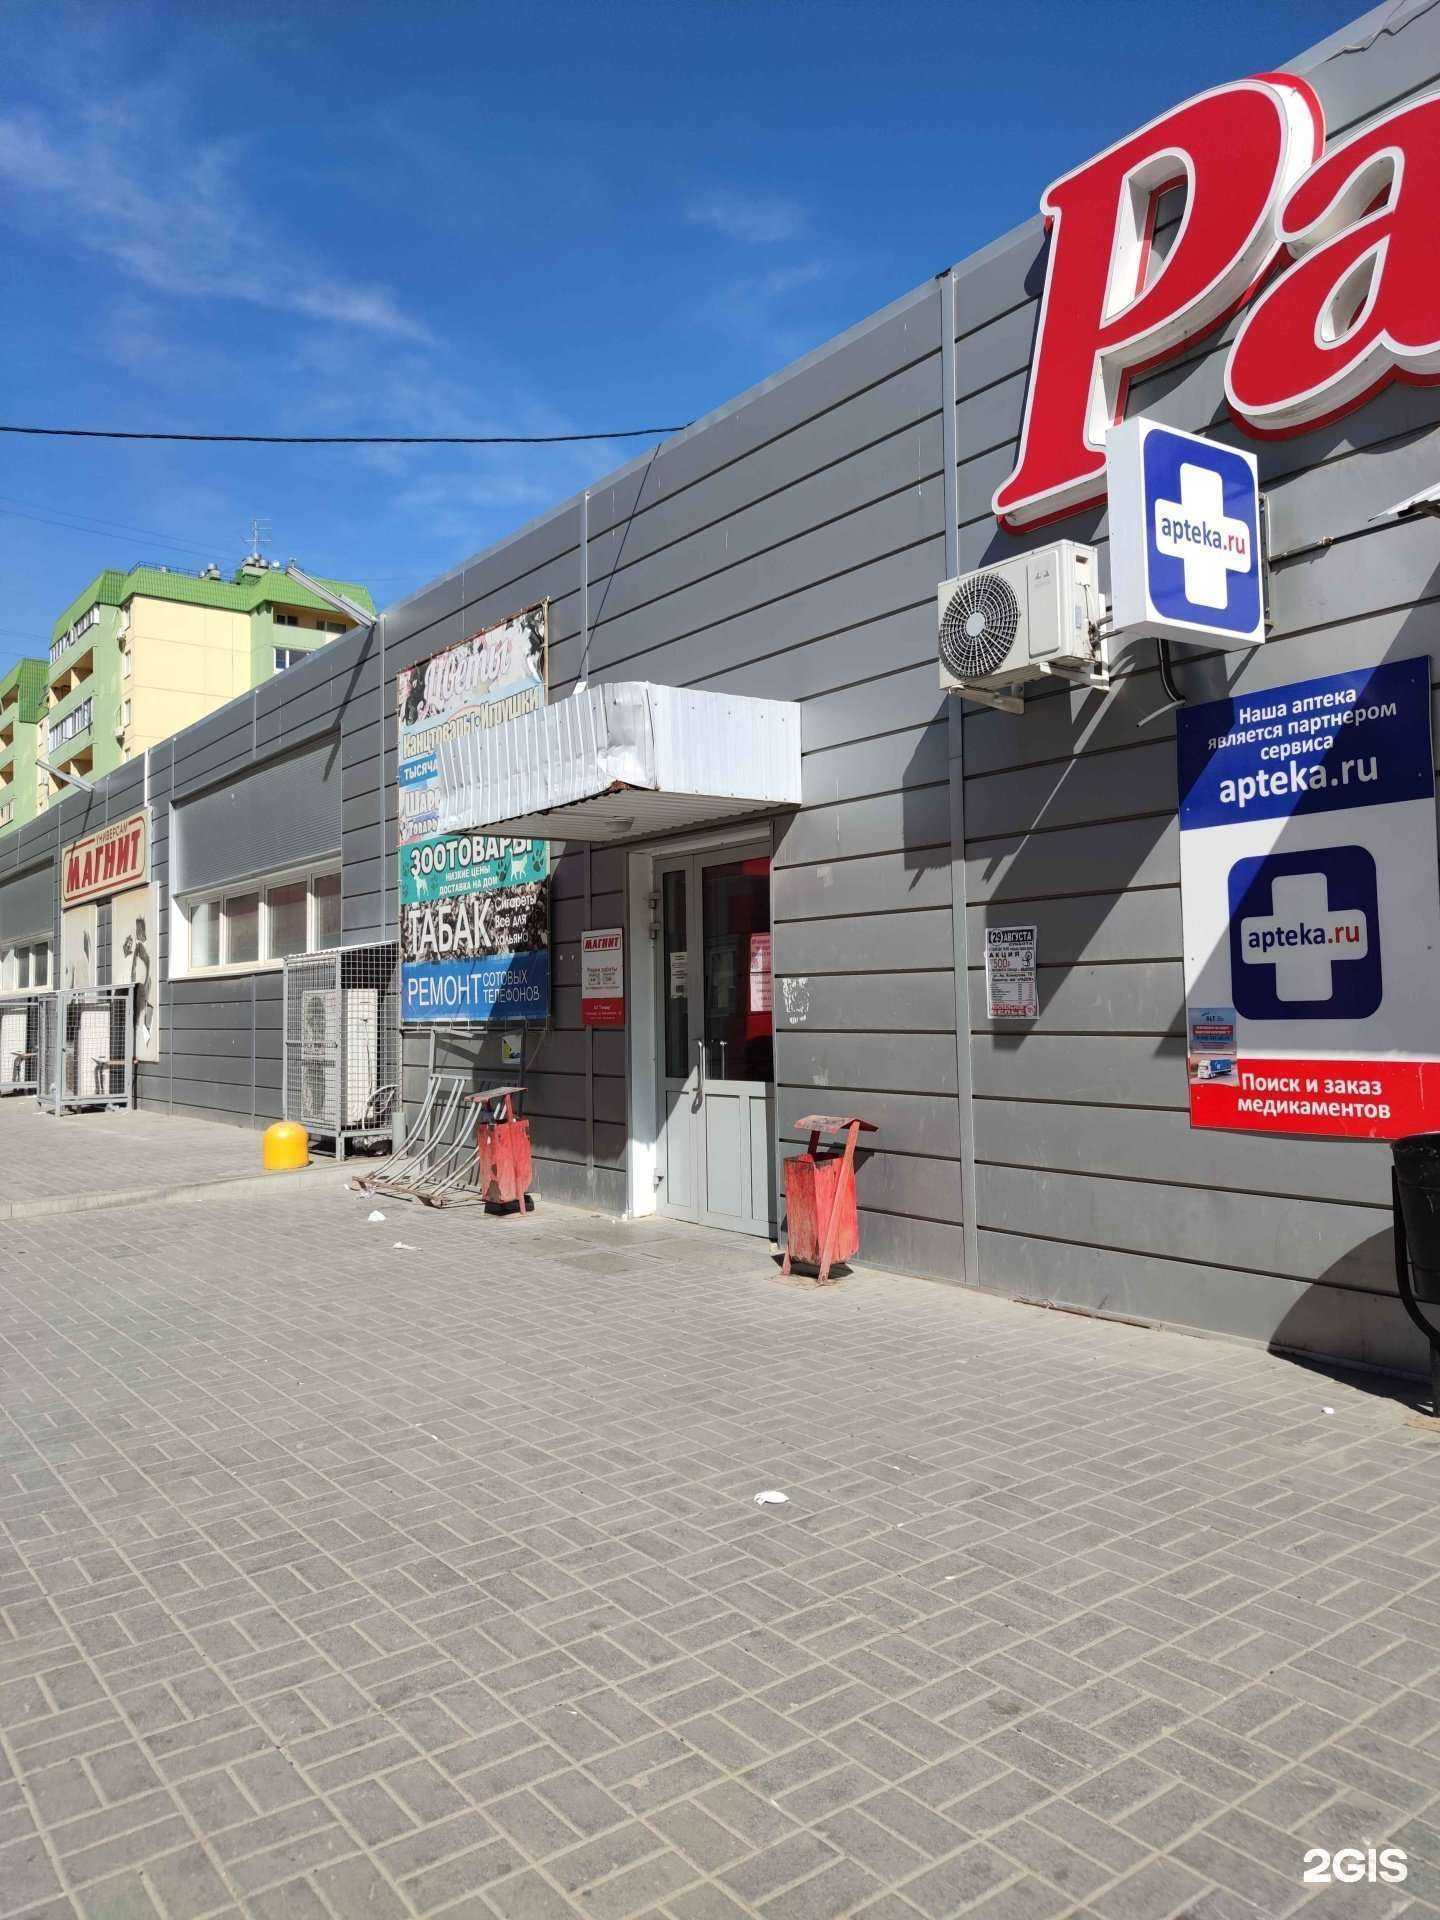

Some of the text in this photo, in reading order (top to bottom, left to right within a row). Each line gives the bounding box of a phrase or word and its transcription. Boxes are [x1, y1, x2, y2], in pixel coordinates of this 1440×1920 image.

[1161, 516, 1246, 555] apteka.ru
[480, 685, 539, 729] Игрушки
[1239, 688, 1356, 724] Наша аптека
[1208, 702, 1397, 750] является партнером
[1260, 735, 1334, 761] сервиса
[1219, 756, 1378, 808] apteka.ru
[66, 828, 141, 893] МАГНИТ
[410, 836, 533, 875] ЗООТОВАРЫ
[439, 876, 498, 896] ДОСТАВКА НА ДОМ
[445, 864, 491, 881] НИЗКИЕ ЦЕНЫ
[408, 899, 492, 955] ТАБАК
[512, 914, 527, 927] для
[1248, 922, 1360, 952] apteka.ru
[585, 937, 619, 950] МАГНИТ
[408, 969, 528, 1006] РЕМОНТ СОТОВЫХ
[483, 986, 540, 1004] ТЕЛЕФОНОВ
[1242, 1073, 1382, 1096] Поиск и заказ
[1237, 1098, 1391, 1119] медикаментов
